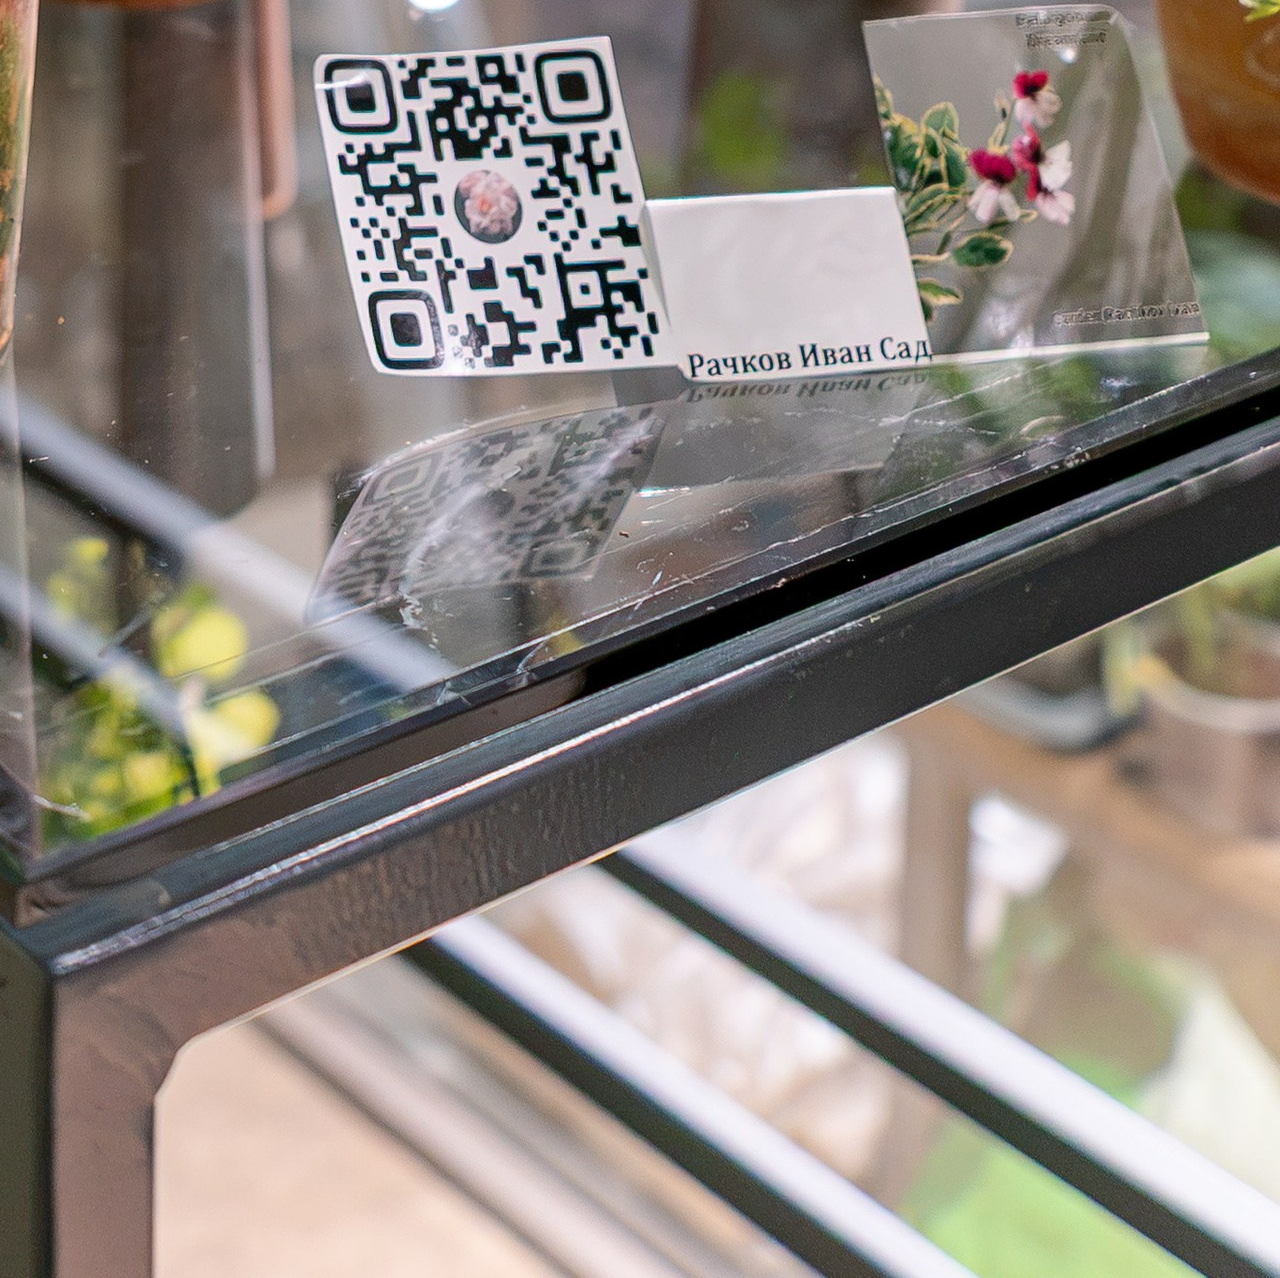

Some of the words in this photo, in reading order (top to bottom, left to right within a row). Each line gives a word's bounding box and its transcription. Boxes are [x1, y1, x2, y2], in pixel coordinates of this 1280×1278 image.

[686, 352, 792, 378] Рачков
[799, 343, 873, 368] Иван
[880, 336, 933, 364] Сад
